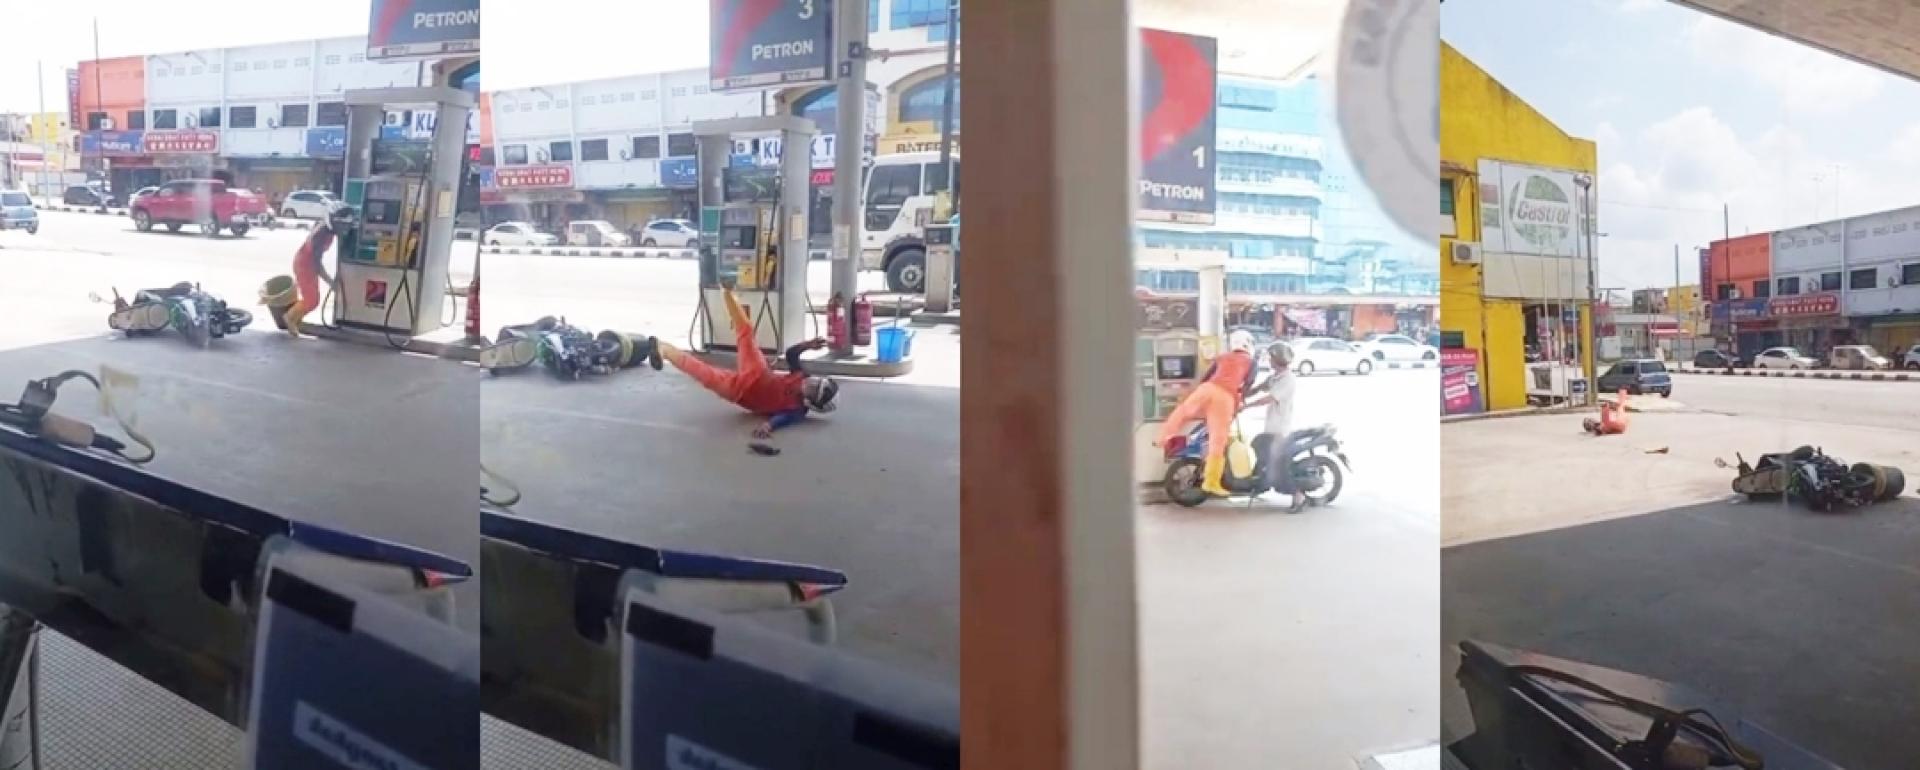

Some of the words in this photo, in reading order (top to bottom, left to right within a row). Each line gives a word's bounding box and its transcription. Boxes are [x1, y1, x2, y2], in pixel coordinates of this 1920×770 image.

[414, 9, 480, 29] PETRON
[798, 0, 814, 20] 3
[751, 39, 814, 61] PETRON
[1192, 146, 1205, 169] 1
[1139, 180, 1204, 201] PETRON
